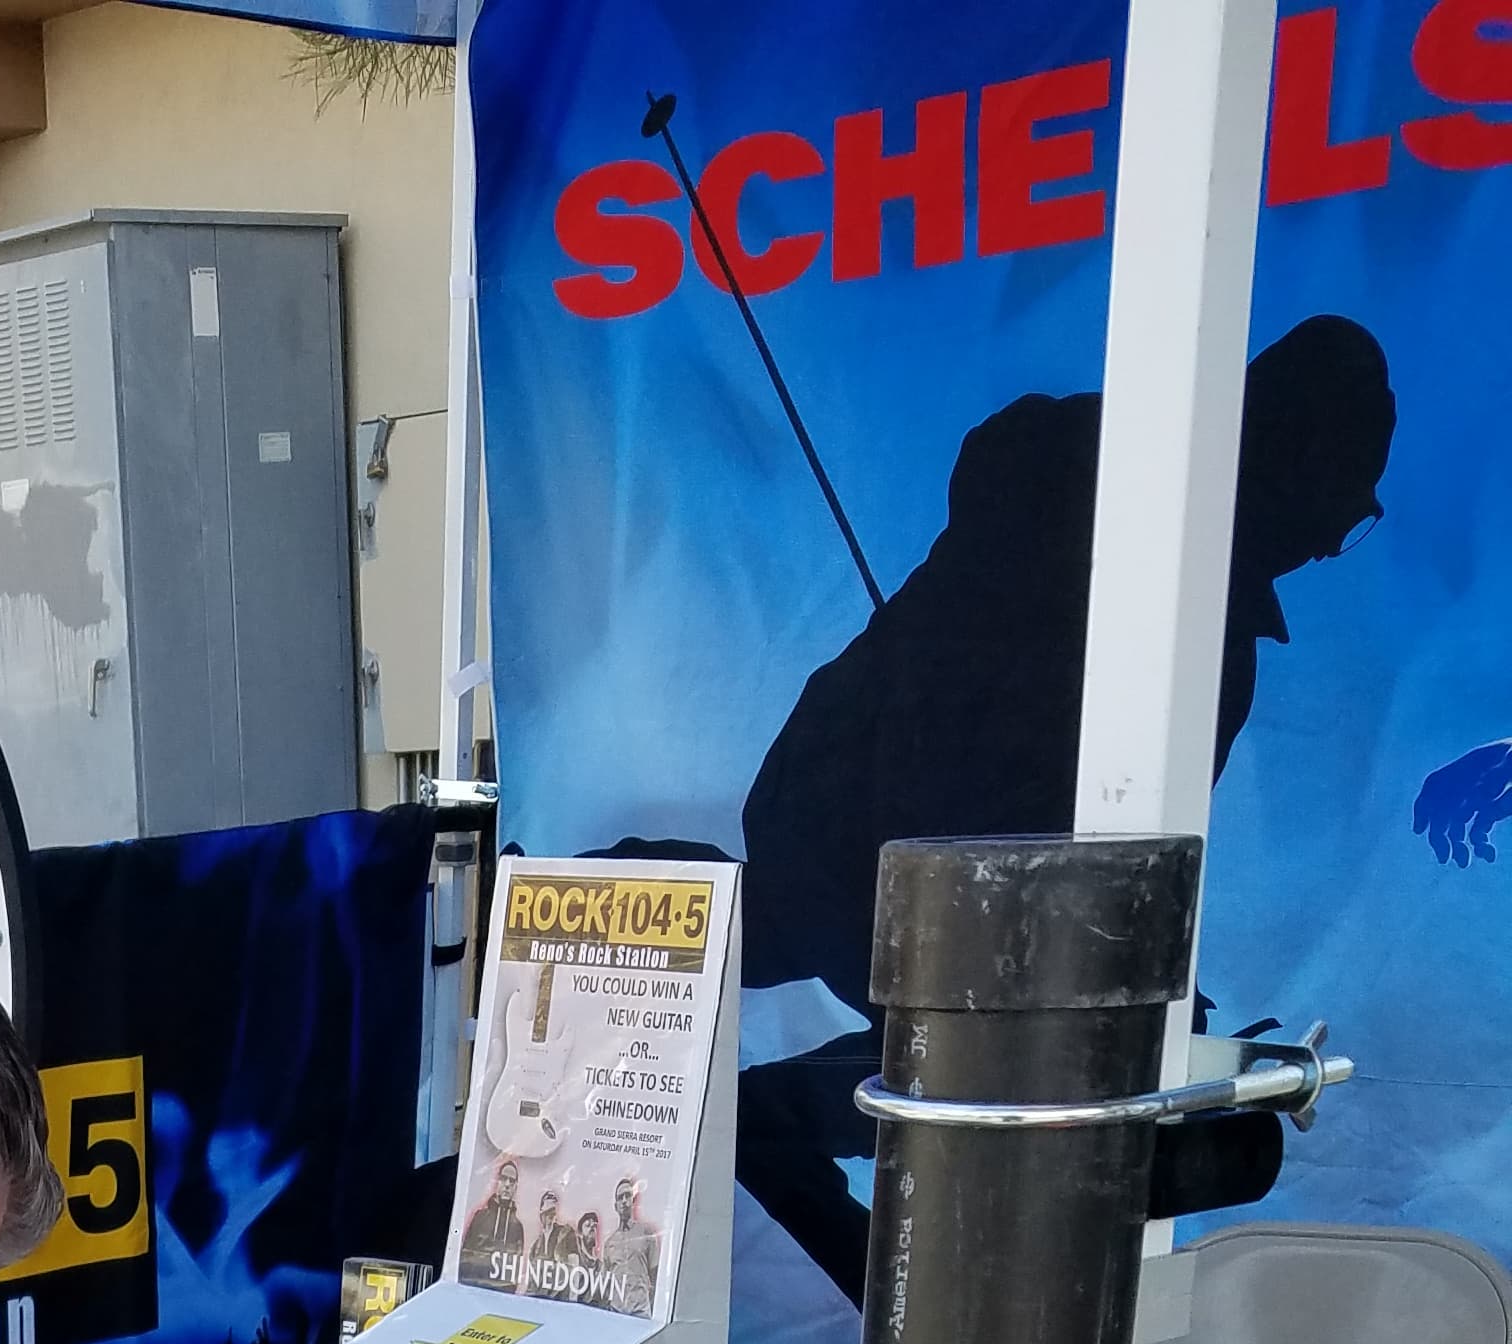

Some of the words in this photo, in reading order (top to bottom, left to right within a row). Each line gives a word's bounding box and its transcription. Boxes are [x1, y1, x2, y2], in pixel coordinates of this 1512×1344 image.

[552, 0, 1512, 320] SCHELS
[509, 885, 613, 934] ROCK
[530, 940, 575, 963] Reno's
[578, 942, 612, 966] Rock
[615, 944, 669, 969] Station
[572, 974, 600, 993] YOU
[602, 976, 648, 997] COULD
[651, 979, 681, 1000] WIN
[682, 982, 693, 1001] A
[607, 1007, 639, 1028] NEW
[642, 1010, 693, 1032] GUITAR
[618, 1040, 659, 1061] ...OR...
[912, 1023, 928, 1058] JM
[584, 1066, 635, 1089] TICKETS
[639, 1072, 657, 1091] TO
[659, 1074, 684, 1094] SEE
[594, 1098, 679, 1124] SHINEDOWN
[582, 1139, 592, 1149] ON
[593, 1141, 622, 1154] SATURDAY
[623, 1144, 640, 1155] APRIL
[656, 1147, 671, 1159] 2017
[594, 1127, 616, 1139] GRAND
[617, 1129, 638, 1142] SIERRA
[639, 1131, 663, 1144] RESORT
[489, 1252, 628, 1303] SHINEDOWN
[889, 1217, 913, 1330] America
[460, 1327, 496, 1344] Enter
[496, 1332, 513, 1344] to
